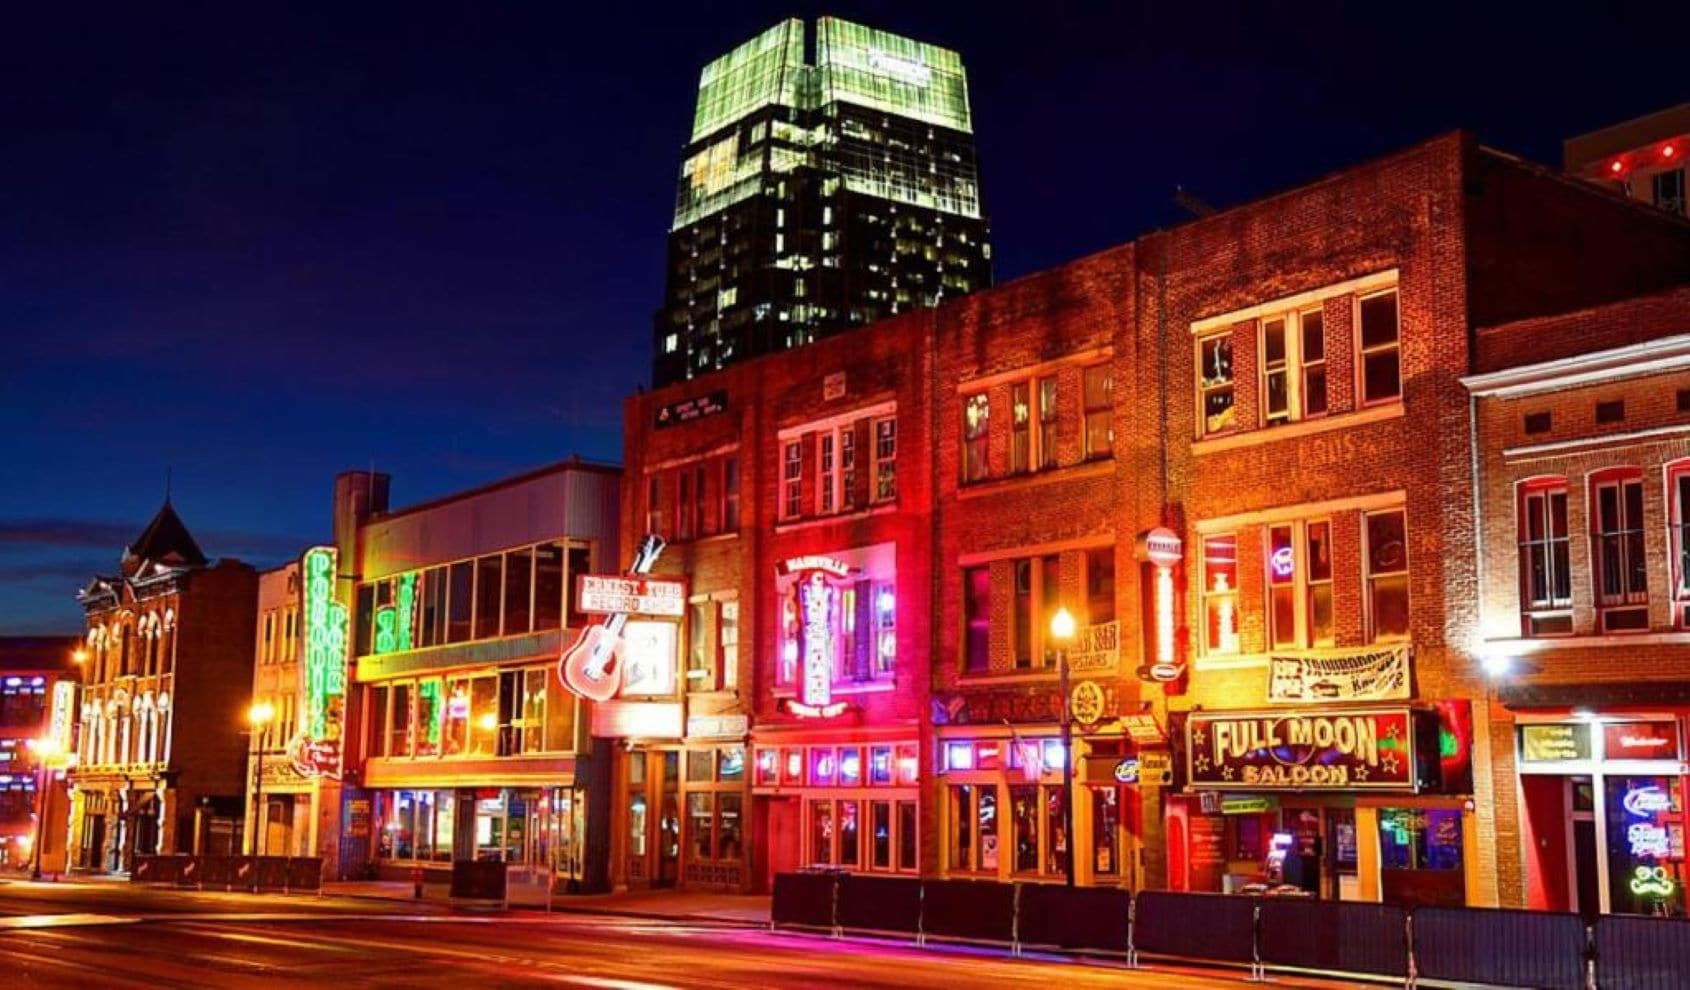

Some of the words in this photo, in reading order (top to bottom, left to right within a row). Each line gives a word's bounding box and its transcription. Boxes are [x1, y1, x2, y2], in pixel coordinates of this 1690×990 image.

[787, 554, 849, 577] NASHVILLE
[309, 552, 331, 740] PARADISE
[326, 605, 347, 694] PARK
[1213, 719, 1282, 767] FULL
[1287, 716, 1379, 767] MOON
[1241, 764, 1350, 785] SALOON
